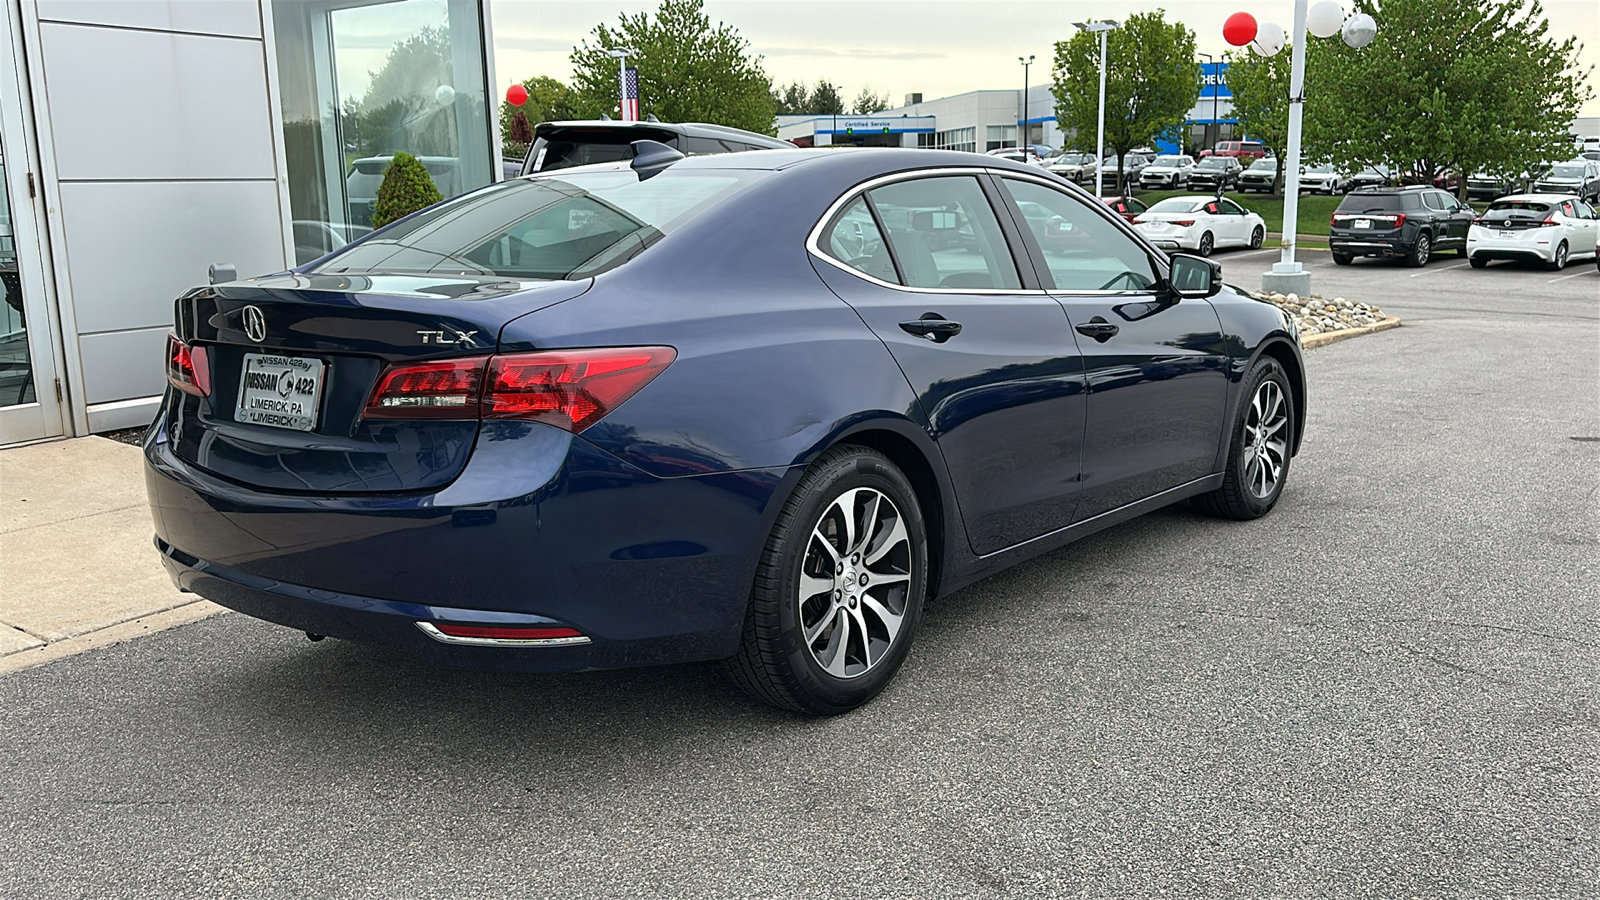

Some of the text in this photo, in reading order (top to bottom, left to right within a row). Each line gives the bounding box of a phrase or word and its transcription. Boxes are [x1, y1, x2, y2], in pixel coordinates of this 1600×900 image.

[416, 331, 478, 344] TLX
[262, 357, 303, 367] NISSAN 422
[247, 372, 314, 395] NISSAN 422
[250, 398, 303, 414] LIMERICK, PA
